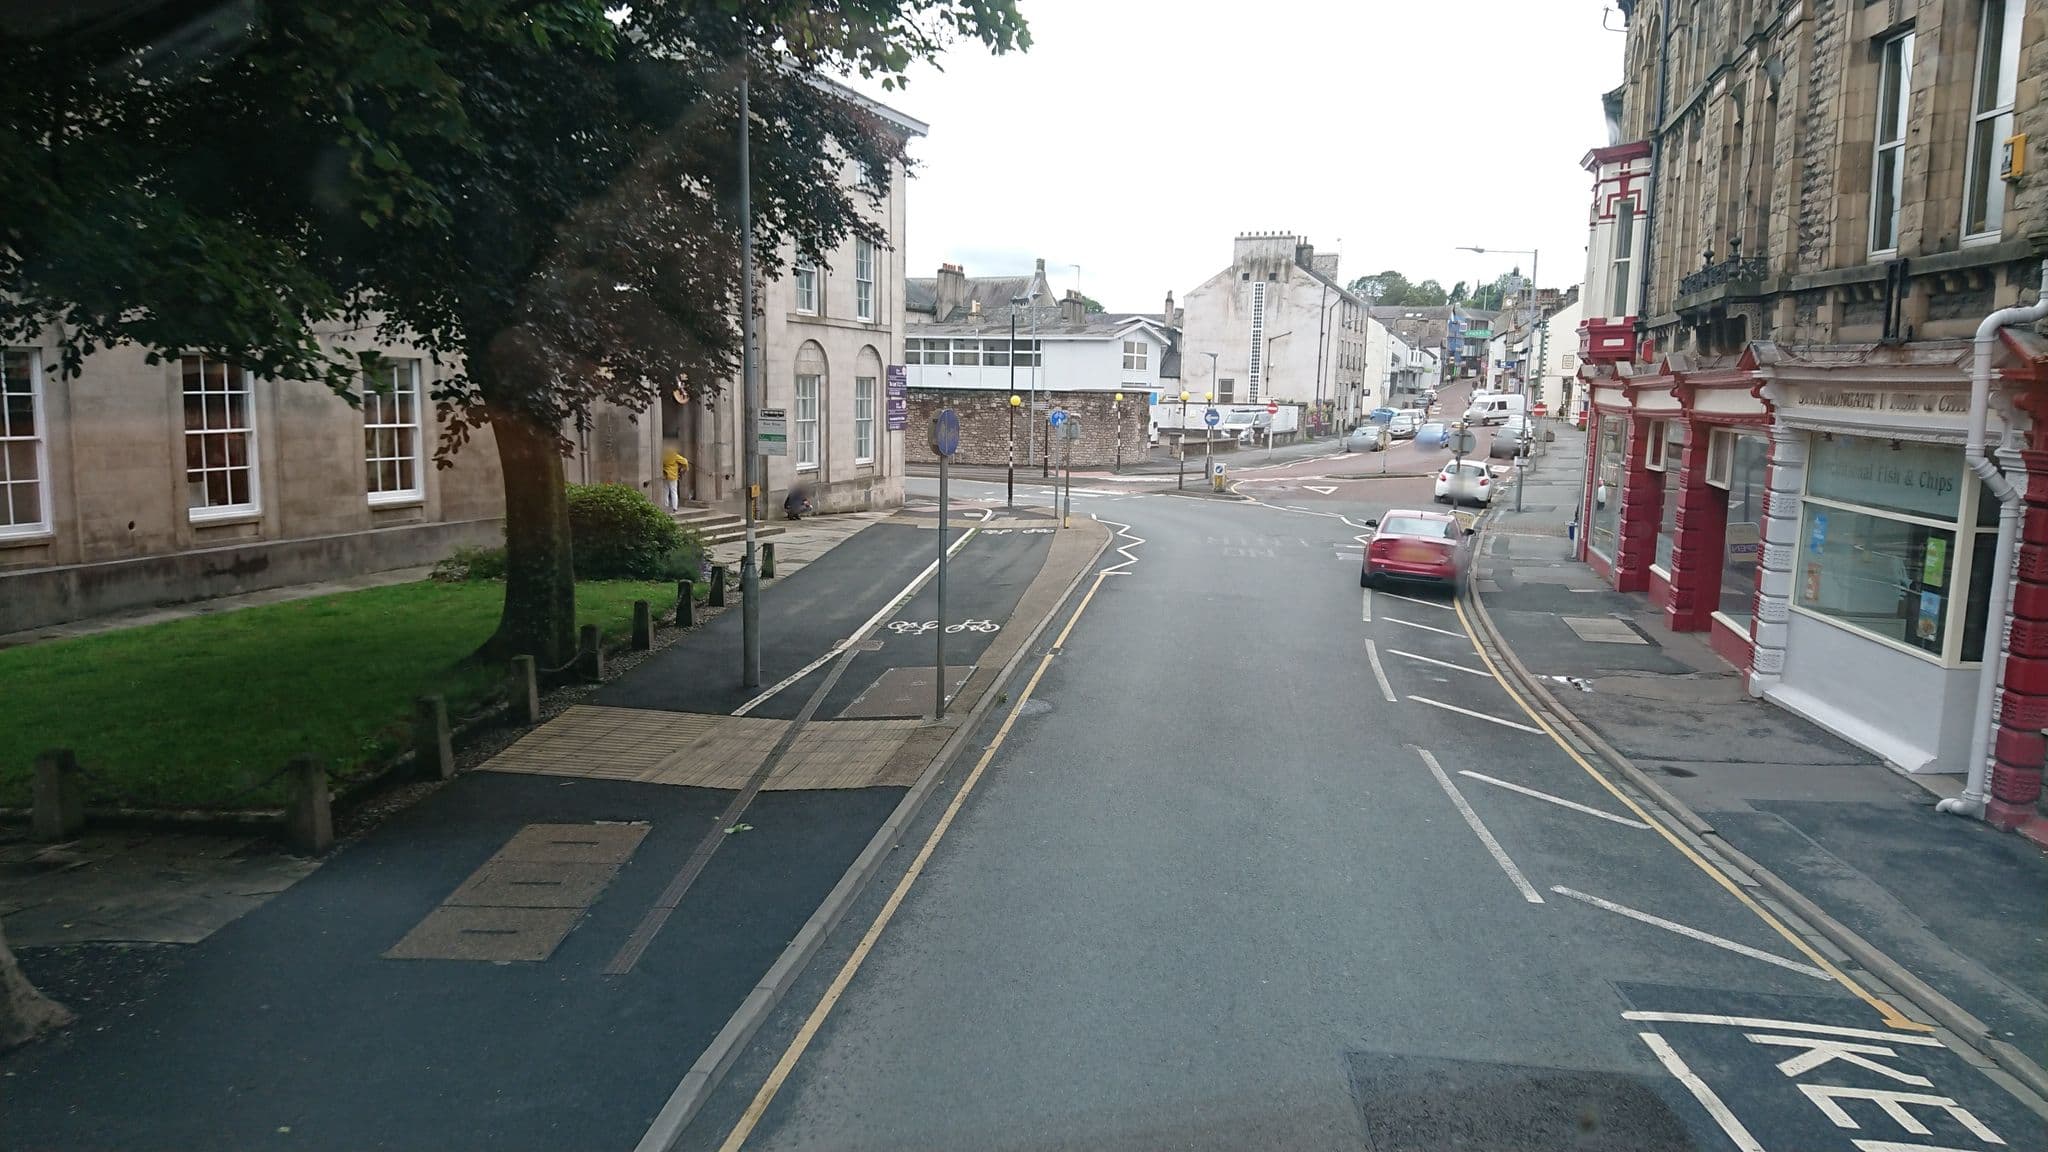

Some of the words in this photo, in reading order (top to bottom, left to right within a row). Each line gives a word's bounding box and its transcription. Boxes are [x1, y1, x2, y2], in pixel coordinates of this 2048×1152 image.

[1878, 464, 1900, 485] Fish
[1904, 469, 1914, 487] &
[1919, 470, 1953, 497] Chips
[1742, 1033, 2008, 1152] KE
